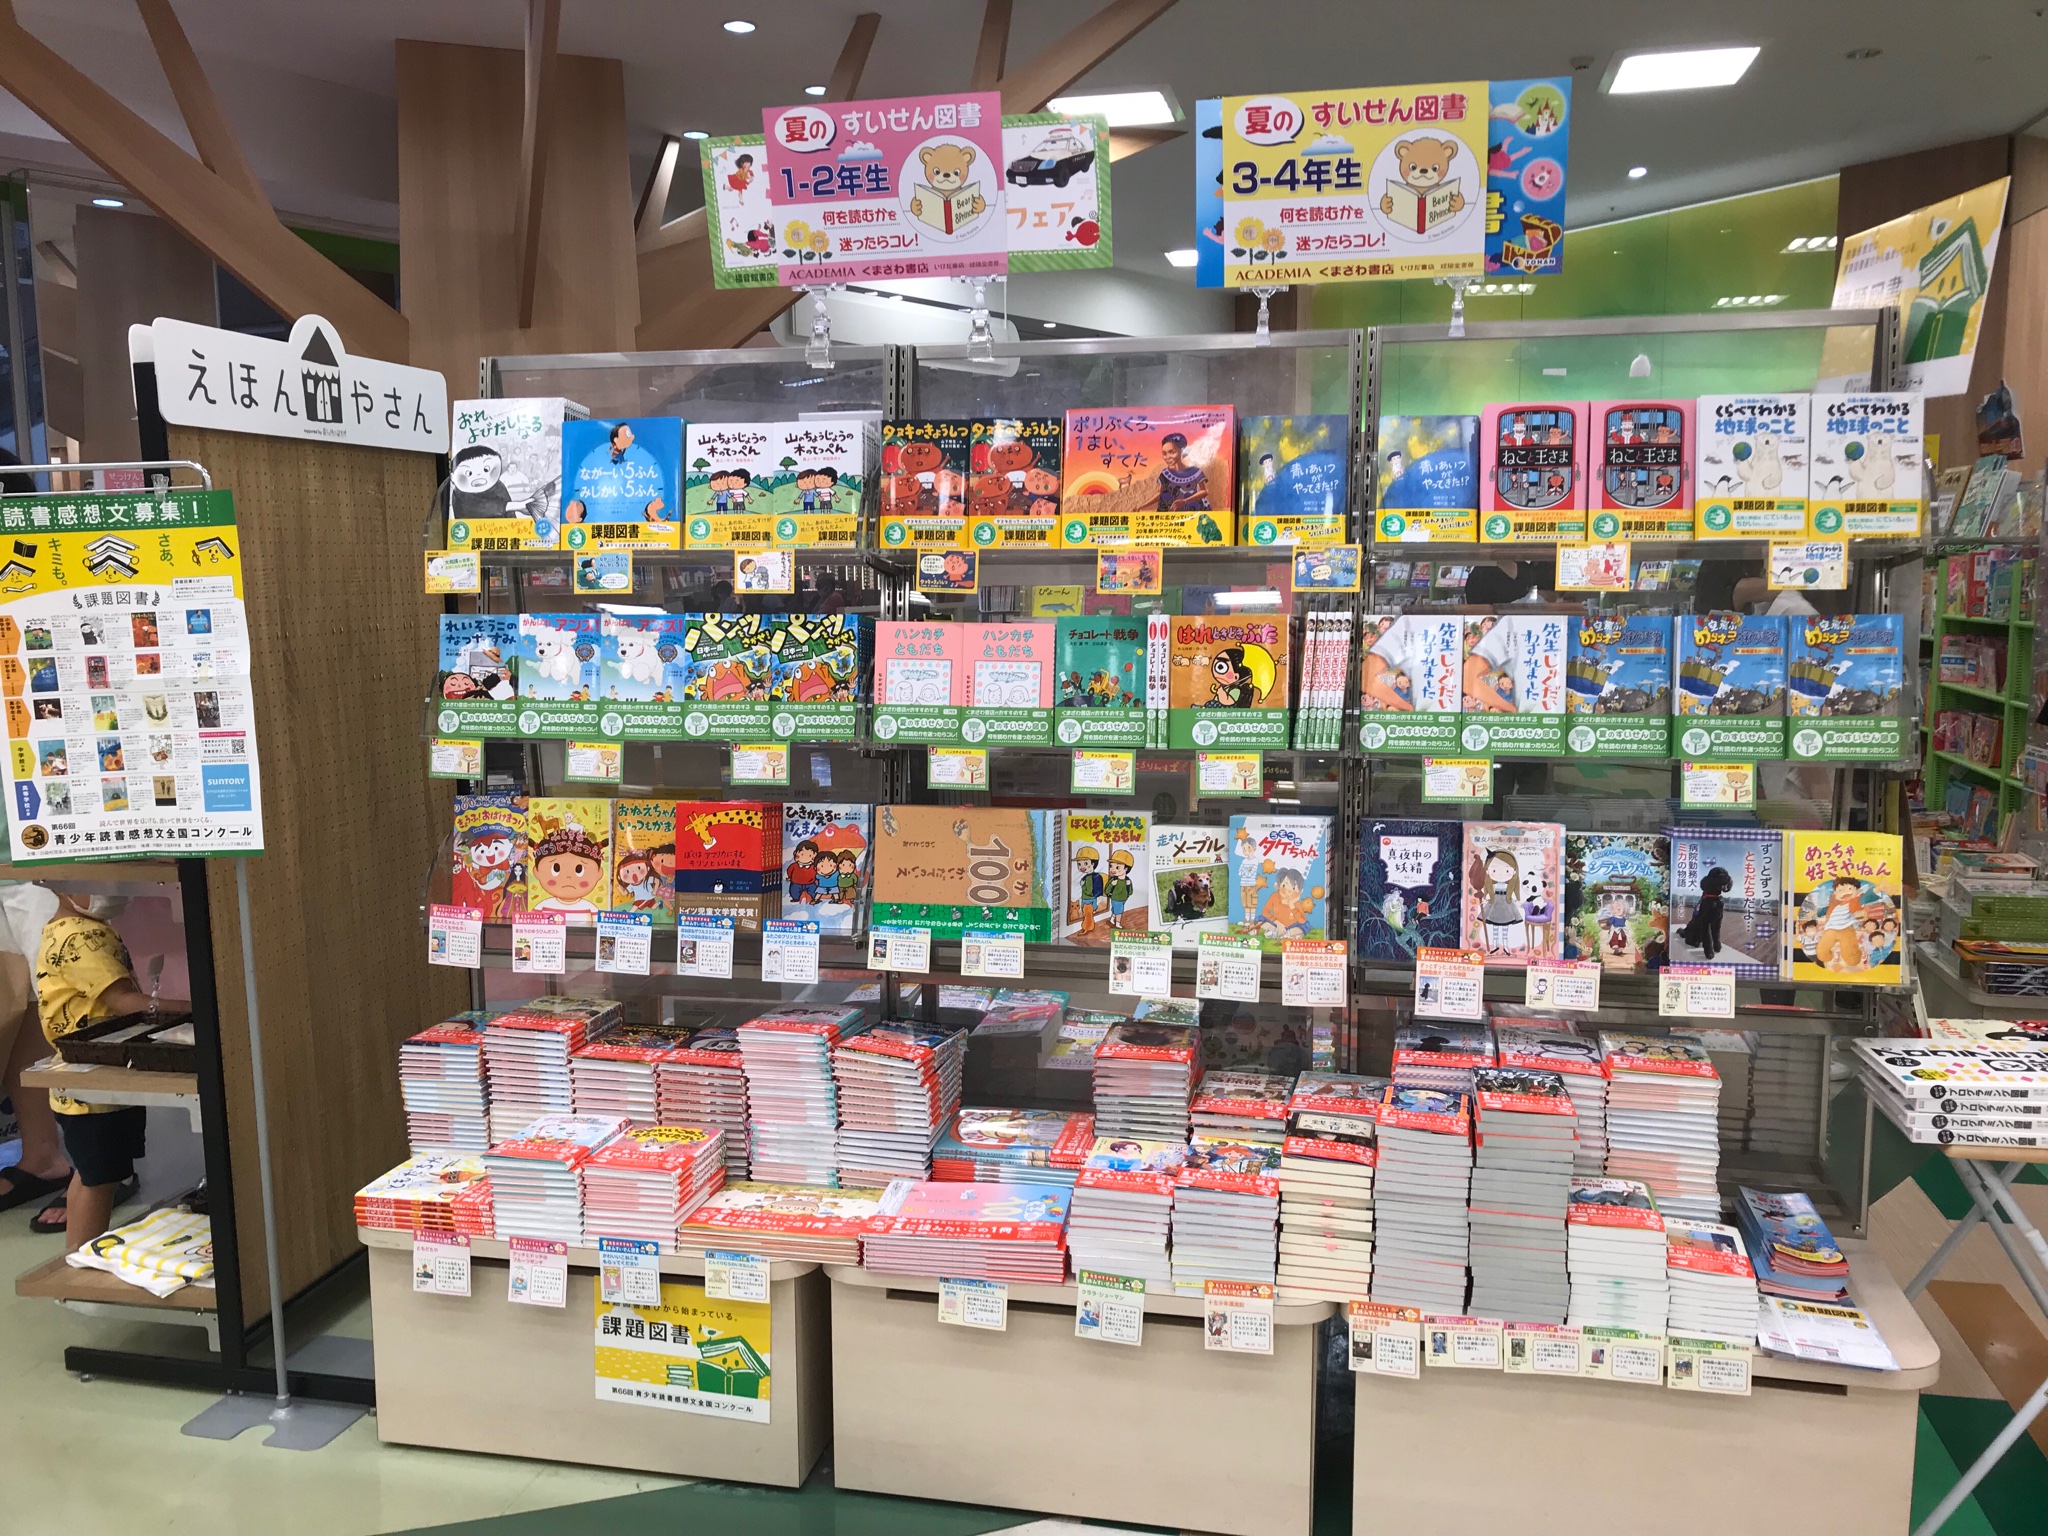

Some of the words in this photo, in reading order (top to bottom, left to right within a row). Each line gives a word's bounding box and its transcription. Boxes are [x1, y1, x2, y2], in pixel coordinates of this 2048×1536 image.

[1312, 93, 1467, 125] すいせん図書
[841, 103, 982, 135] すいせん図書
[1245, 106, 1294, 134] 夏の
[784, 115, 828, 143] 夏の
[780, 165, 891, 199] 1-2年生
[1232, 158, 1363, 194] 3-4年生
[822, 207, 897, 225] 何を読むかを
[1006, 203, 1074, 230] フェア
[1279, 206, 1364, 223] 何を読むかを
[839, 234, 919, 252] 迷ったらコレ!
[1296, 233, 1386, 251] 迷ったらコレ!
[1525, 256, 1555, 267] TOHAN
[788, 267, 856, 280] ACADEMIA
[861, 262, 929, 276] くまざわ書店
[1235, 267, 1311, 280] ACADEMIA
[1319, 264, 1394, 277] くまざわ書店
[188, 349, 298, 417] えほん
[351, 380, 432, 434] やさん
[1715, 404, 1797, 418] くらべてわかる
[1827, 403, 1910, 418] くらべてわかる
[883, 422, 968, 440] タヌキのきょうしつ
[1074, 416, 1155, 433] ポリぶくろ、
[1715, 418, 1795, 435] 地球のこと
[1826, 418, 1909, 435] 地球のこと
[698, 432, 767, 446] 山のちょうじょうの
[785, 431, 854, 444] 山のちょうじょうの
[1075, 435, 1124, 451] 1まい、
[707, 446, 760, 457] 木のてっぺん
[794, 445, 847, 456] 木のてっぺん
[1502, 449, 1569, 465] ねこと王さま
[1610, 448, 1678, 464] ねこと王さま
[1101, 453, 1148, 468] すてた
[580, 462, 658, 480] ながーい5ふん
[1291, 462, 1336, 479] 青いあいつ
[1419, 461, 1467, 478] 青いあいつ
[580, 480, 658, 498] みじかい5ふん
[3, 500, 199, 527] 読書感想文募集!
[1089, 516, 1129, 526] 課題図書
[591, 525, 639, 539] 課題図書
[1514, 522, 1557, 532] 課題図書
[1622, 521, 1666, 531] 課題図書
[732, 531, 771, 541] 課題図書
[819, 531, 856, 541] 課題図書
[914, 531, 955, 540] 課題図書
[1005, 531, 1047, 540] 課題図書
[471, 538, 521, 550] 課題図書
[84, 590, 149, 607] 課題図書
[1039, 587, 1070, 596] ぴょーん
[445, 620, 517, 632] れいぞうこの
[555, 618, 600, 632] アンズ!
[637, 618, 683, 633] アンズ!
[446, 633, 517, 645] なつやすみ
[894, 628, 945, 640] ハンカチ
[982, 630, 1034, 642] ハンカチ
[1068, 628, 1139, 640] チョコレート戦争
[1177, 623, 1278, 644] はれときどきぶた
[895, 644, 944, 656] ともだち
[983, 646, 1033, 658] ともだち
[460, 714, 517, 722] 夏のすいせん図書
[541, 714, 598, 723] 夏のすいせん図書
[624, 714, 683, 726] 夏のすいせん図書
[709, 714, 770, 725] 夏のすいせん図書
[796, 714, 855, 725] 夏のすいせん図書
[899, 719, 958, 729] 夏のすいせん図書
[986, 721, 1048, 732] 夏のすいせん図書
[1083, 721, 1145, 731] 夏のすいせん図書
[1219, 723, 1284, 733] 夏のすいせん図書
[207, 778, 245, 786] SUNTORY
[785, 806, 841, 826] ひきがえるに
[1070, 817, 1100, 829] ぼくは
[1102, 816, 1144, 829] なんでも
[52, 823, 76, 831] 第66回
[785, 821, 819, 838] げんまん
[54, 827, 252, 845] 青少年読書感想文全国コンクール
[1092, 830, 1141, 843] できるもん
[1156, 832, 1184, 848] 走れ!
[1269, 829, 1302, 847] うそつき
[1172, 836, 1226, 858] メープル
[1258, 836, 1318, 858] タケちゃん
[1387, 848, 1432, 861] 真夜中の
[1804, 843, 1855, 861] めっちゃ
[968, 836, 1011, 904] 100
[1395, 861, 1423, 876] 妖精
[1677, 843, 1687, 888] ミカの物語
[1804, 860, 1891, 880] 好きやねん
[897, 866, 966, 881] かいだてのいえ
[1013, 859, 1029, 896] ちか
[1760, 843, 1773, 916] ずっとずっと、
[678, 907, 759, 917] ドイツ児童文学賞受賞!
[602, 1316, 690, 1345] 課題図書
[612, 1387, 633, 1396] 第66回
[636, 1389, 753, 1413] 青少年読書感想文全国コンクール
